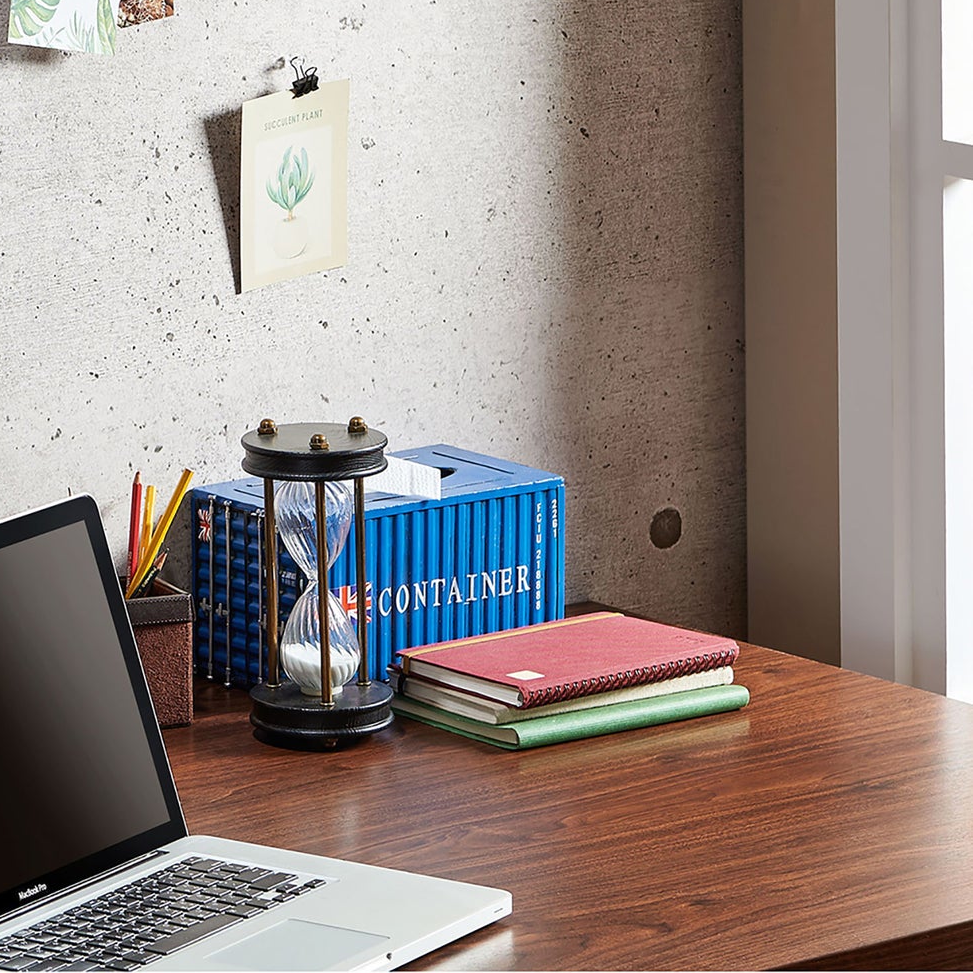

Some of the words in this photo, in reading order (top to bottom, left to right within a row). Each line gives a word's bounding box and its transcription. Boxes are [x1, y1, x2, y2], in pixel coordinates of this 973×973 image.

[264, 113, 299, 131] SUCCULENT
[301, 109, 323, 122] PLANT
[378, 564, 531, 617] CONTAINER
[18, 884, 39, 901] MacBook
[38, 883, 47, 892] Pro
